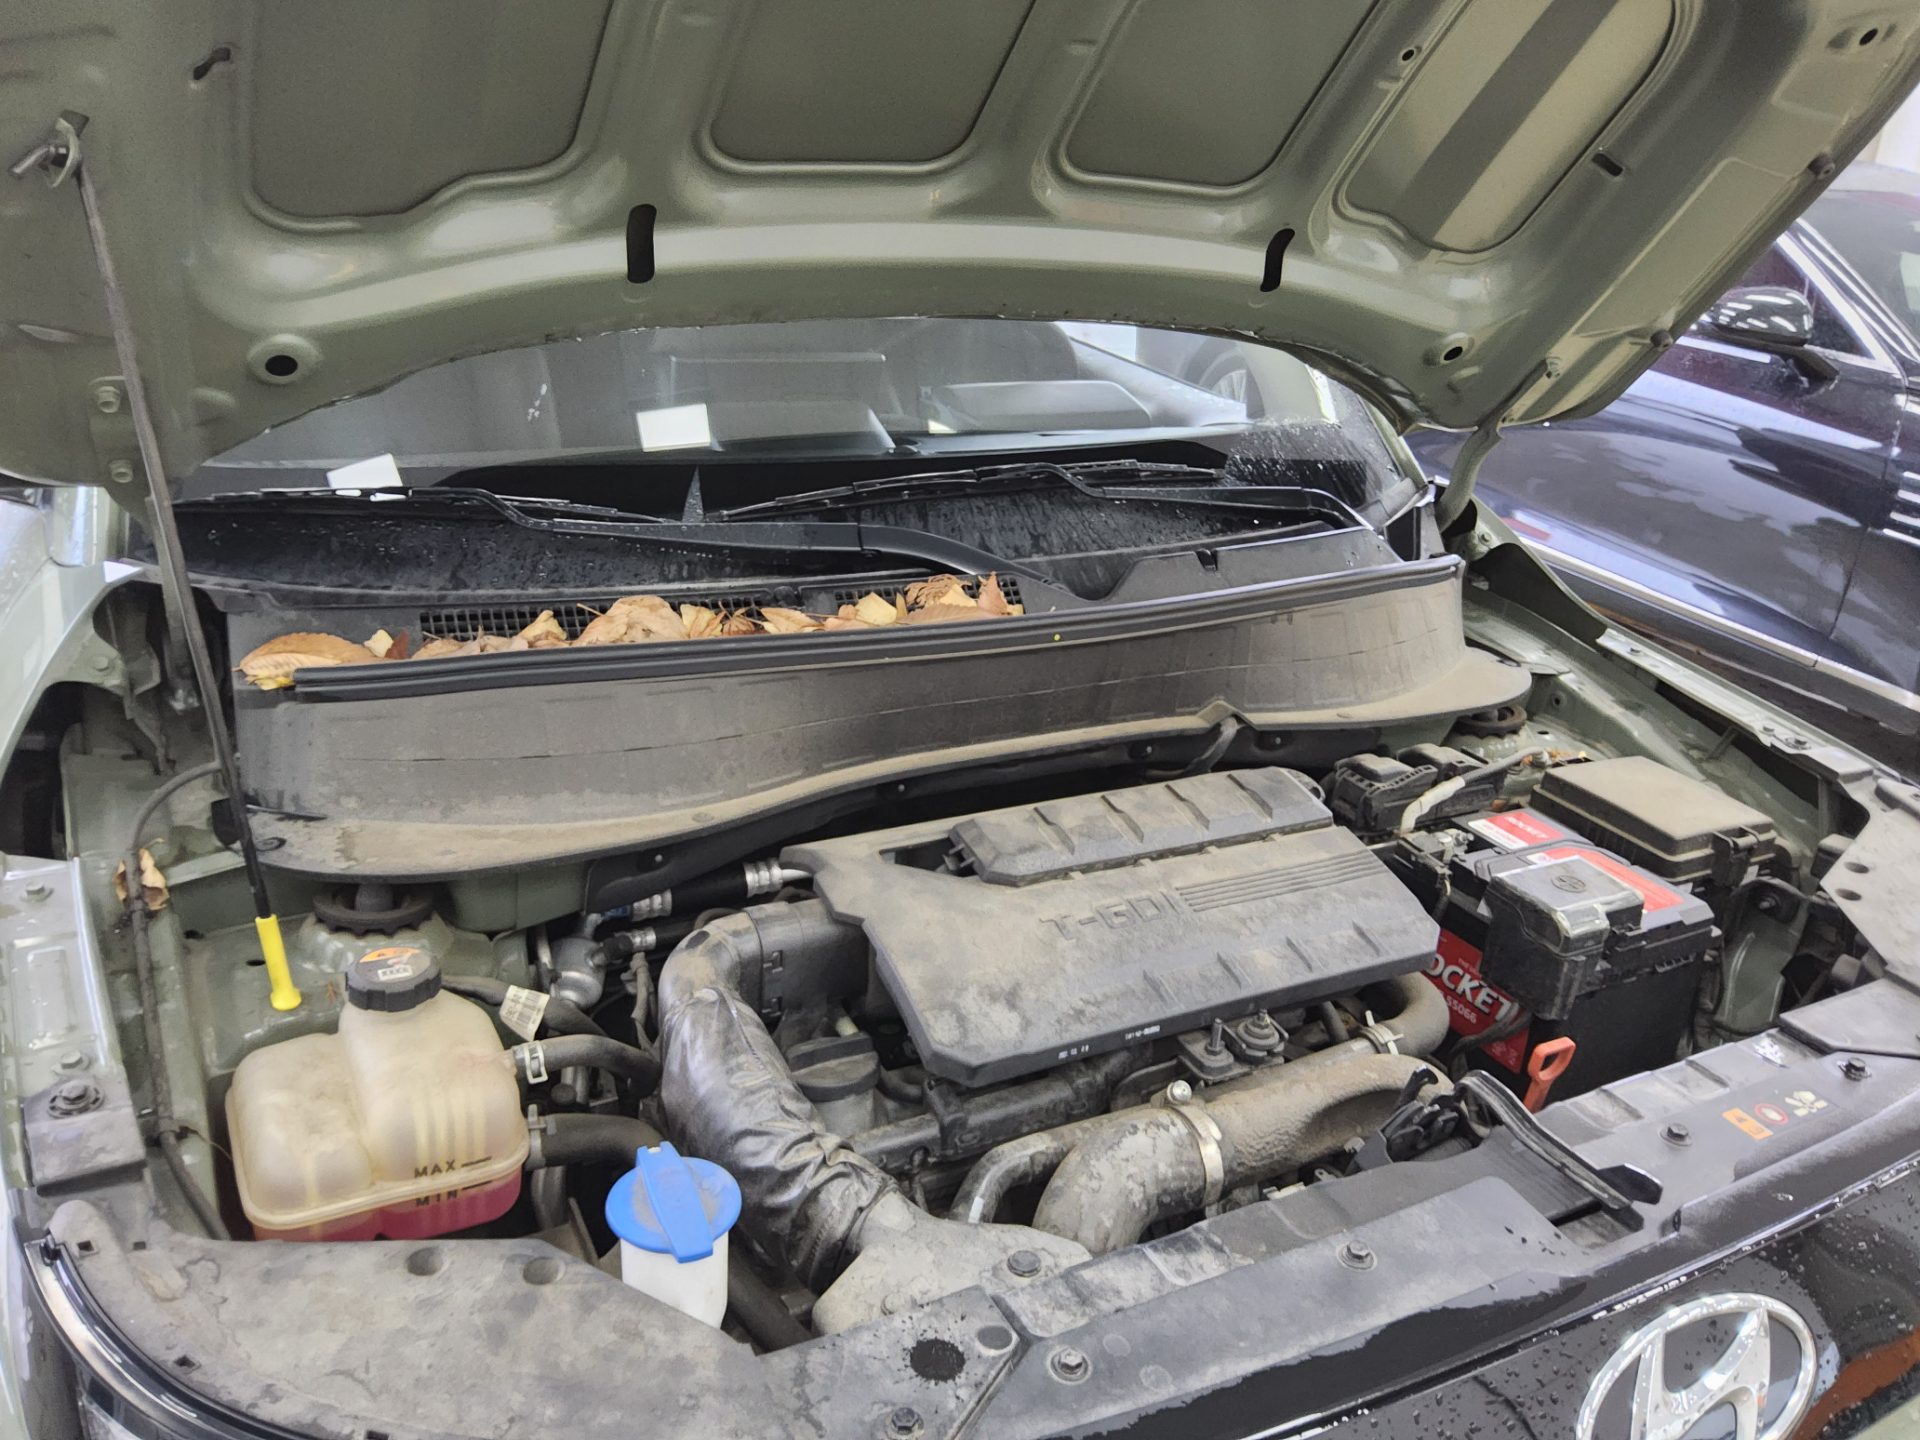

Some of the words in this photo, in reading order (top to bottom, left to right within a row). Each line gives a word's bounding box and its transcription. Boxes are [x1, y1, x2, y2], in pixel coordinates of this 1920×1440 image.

[1422, 952, 1519, 1022] OCKET
[414, 1160, 456, 1179] MAX
[415, 1189, 458, 1207] MIN
